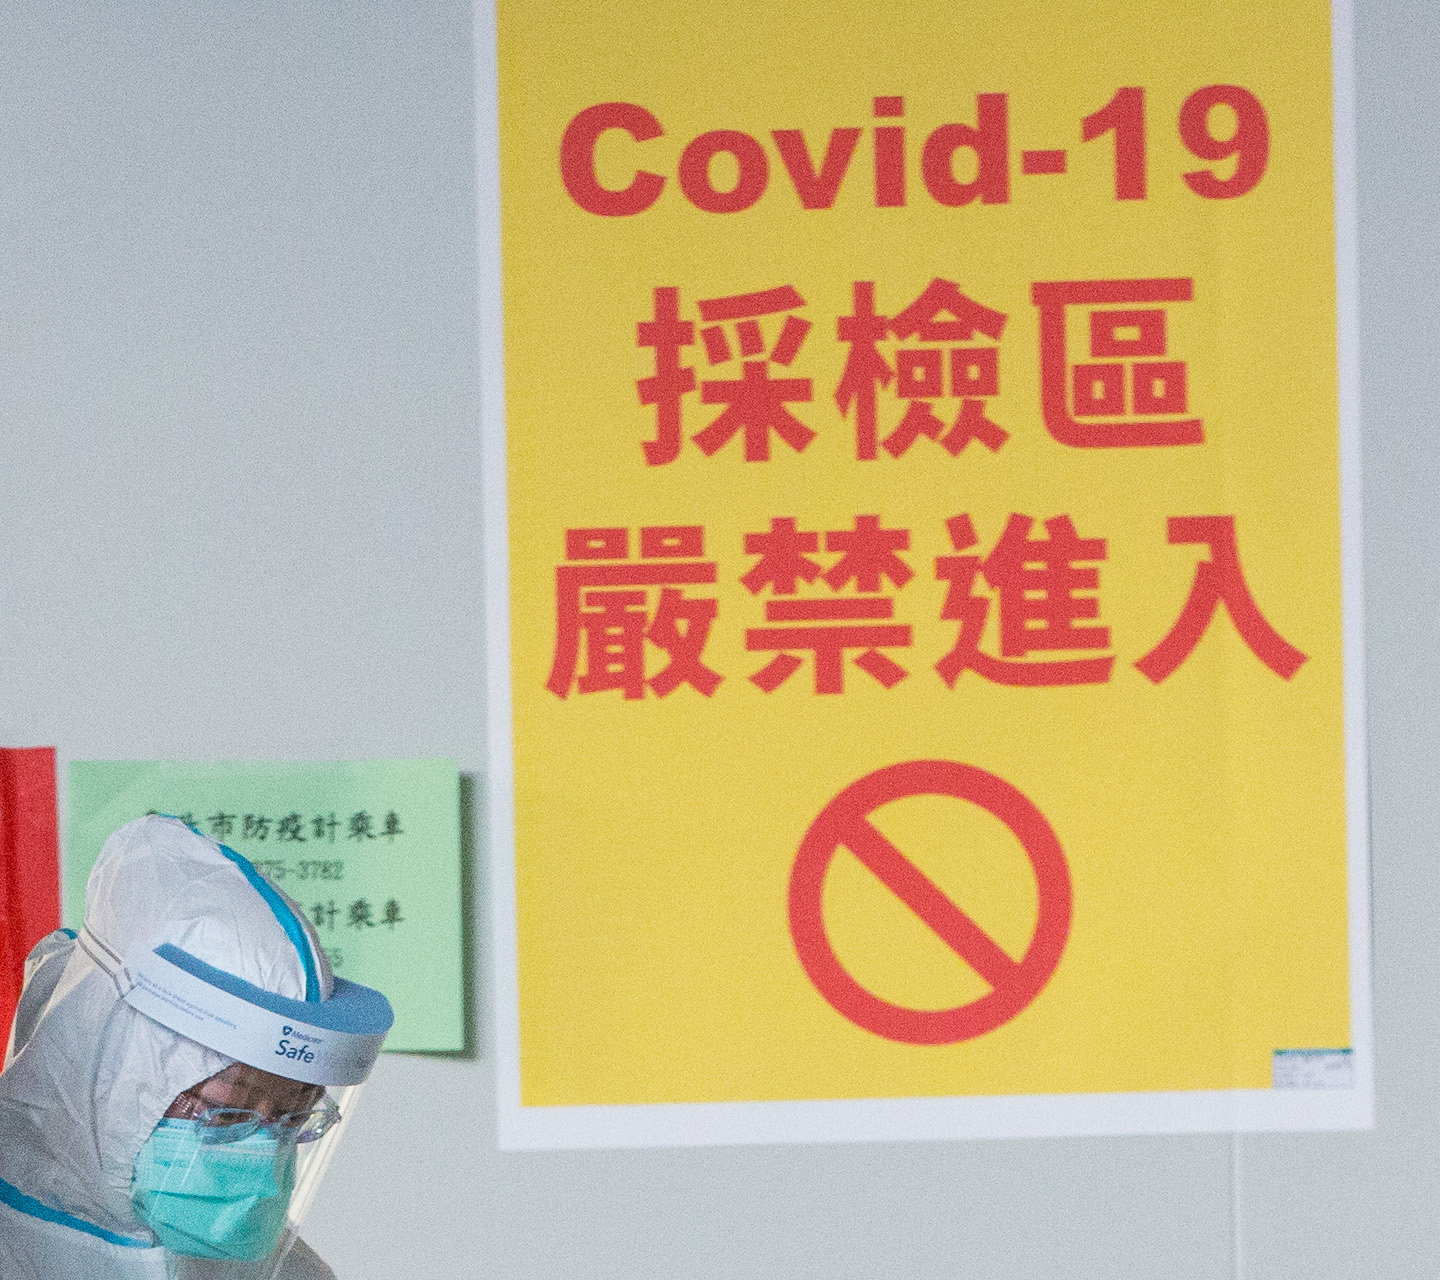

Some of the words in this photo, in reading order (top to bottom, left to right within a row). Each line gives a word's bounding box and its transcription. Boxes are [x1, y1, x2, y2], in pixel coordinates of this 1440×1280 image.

[558, 83, 1271, 218] Covid-19
[635, 276, 1206, 467] 採檢區
[543, 511, 1310, 701] 嚴禁進入
[275, 1039, 315, 1064] Safe
